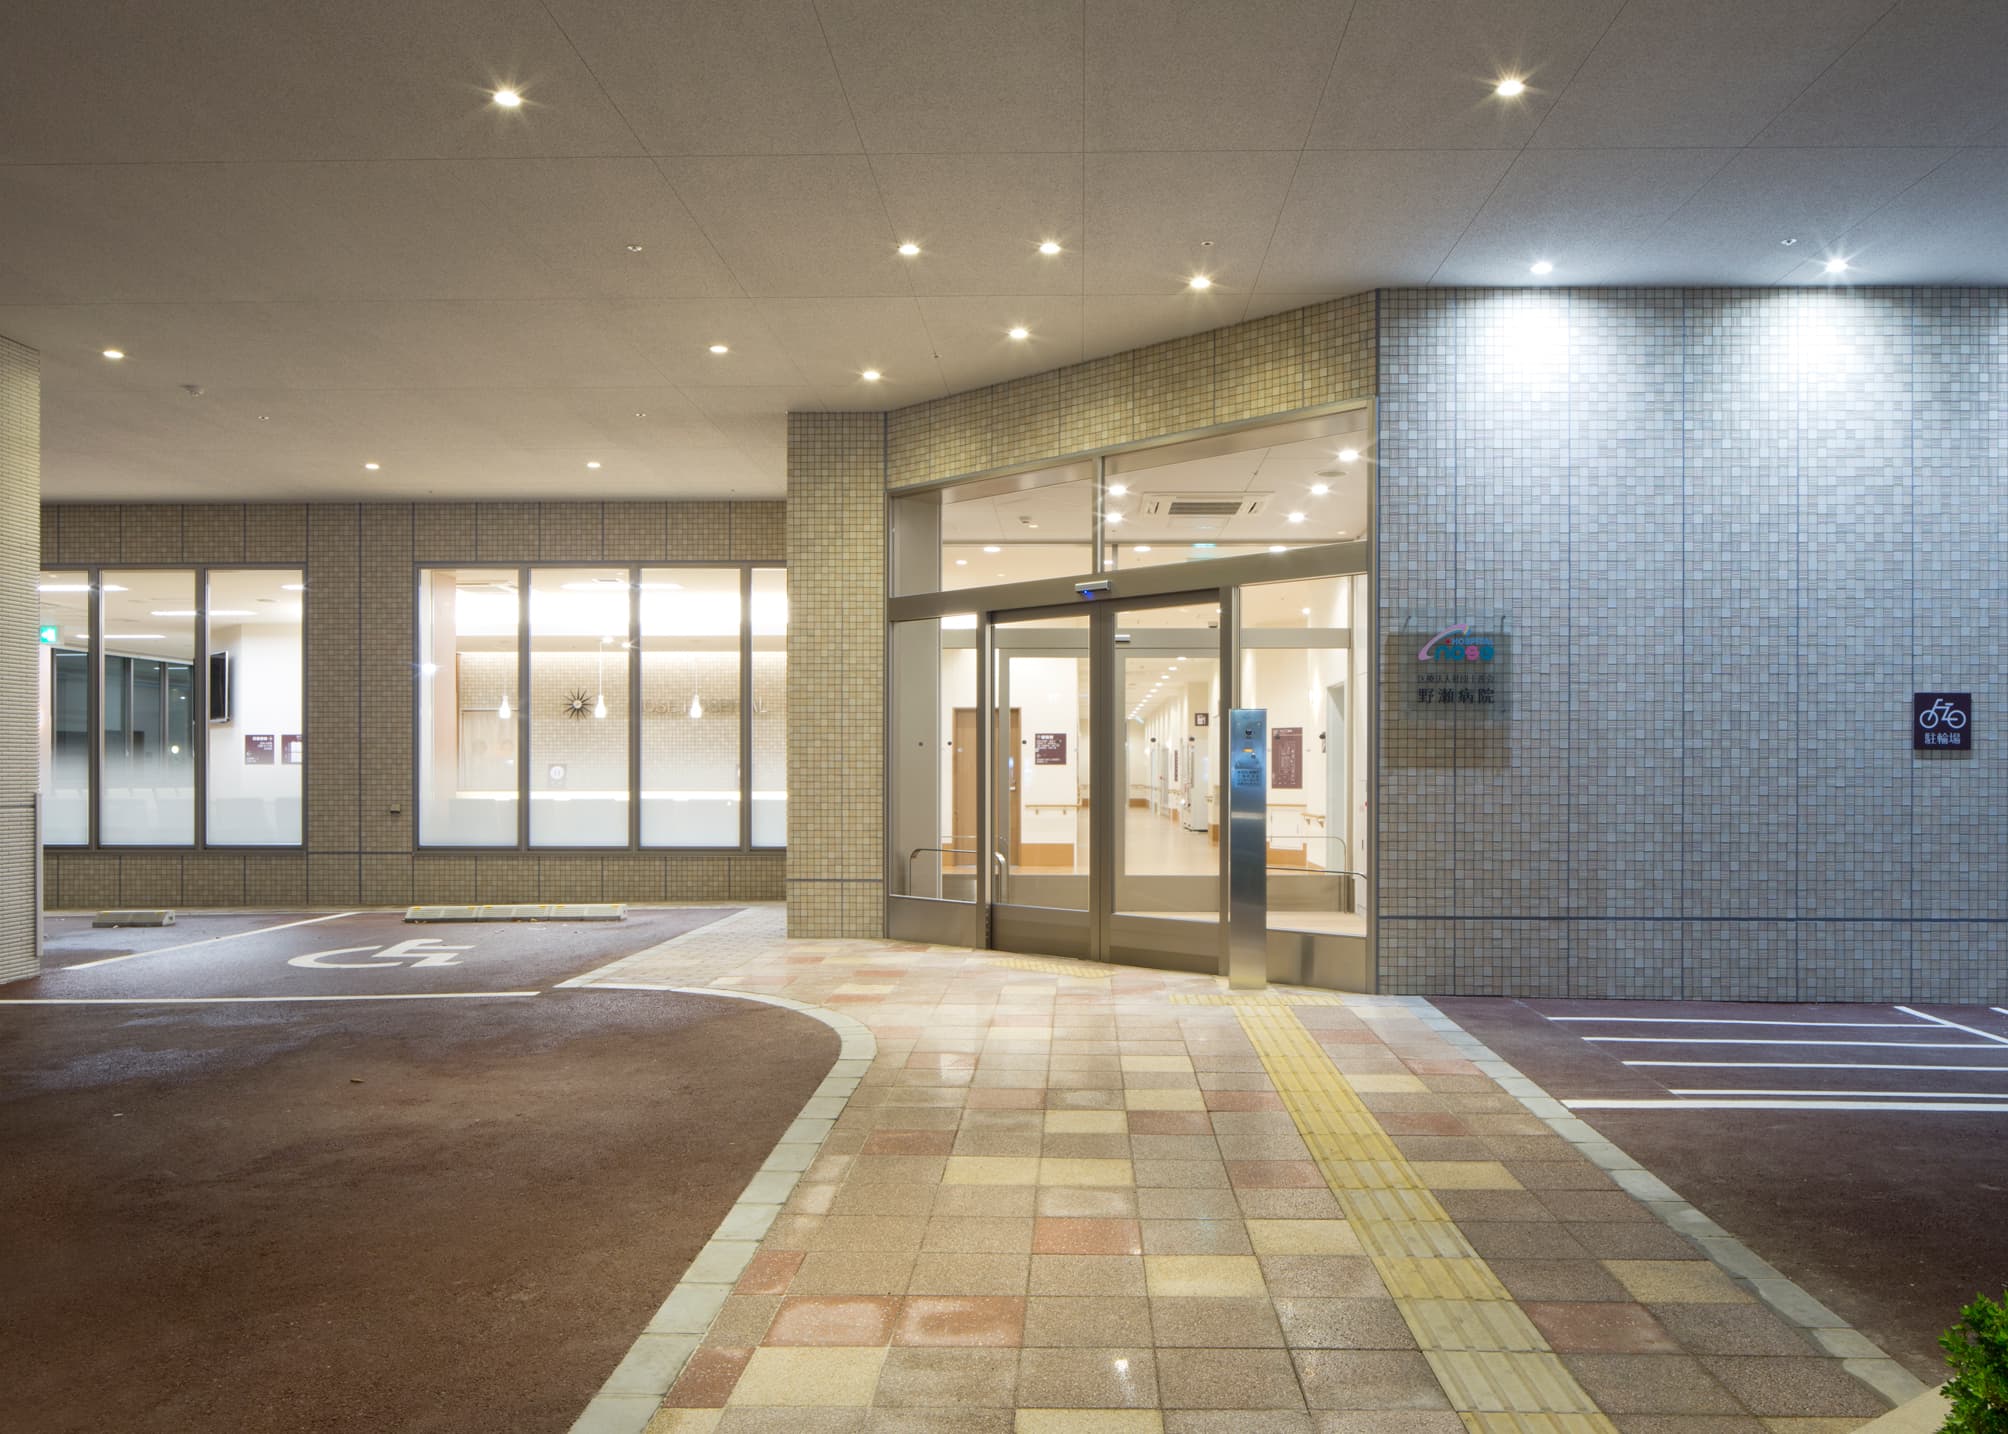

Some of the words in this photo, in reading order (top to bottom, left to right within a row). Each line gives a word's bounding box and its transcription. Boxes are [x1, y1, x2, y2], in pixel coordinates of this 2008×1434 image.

[1417, 687, 1495, 704] 野瀬病院
[1924, 732, 1961, 745] 駐輪場
